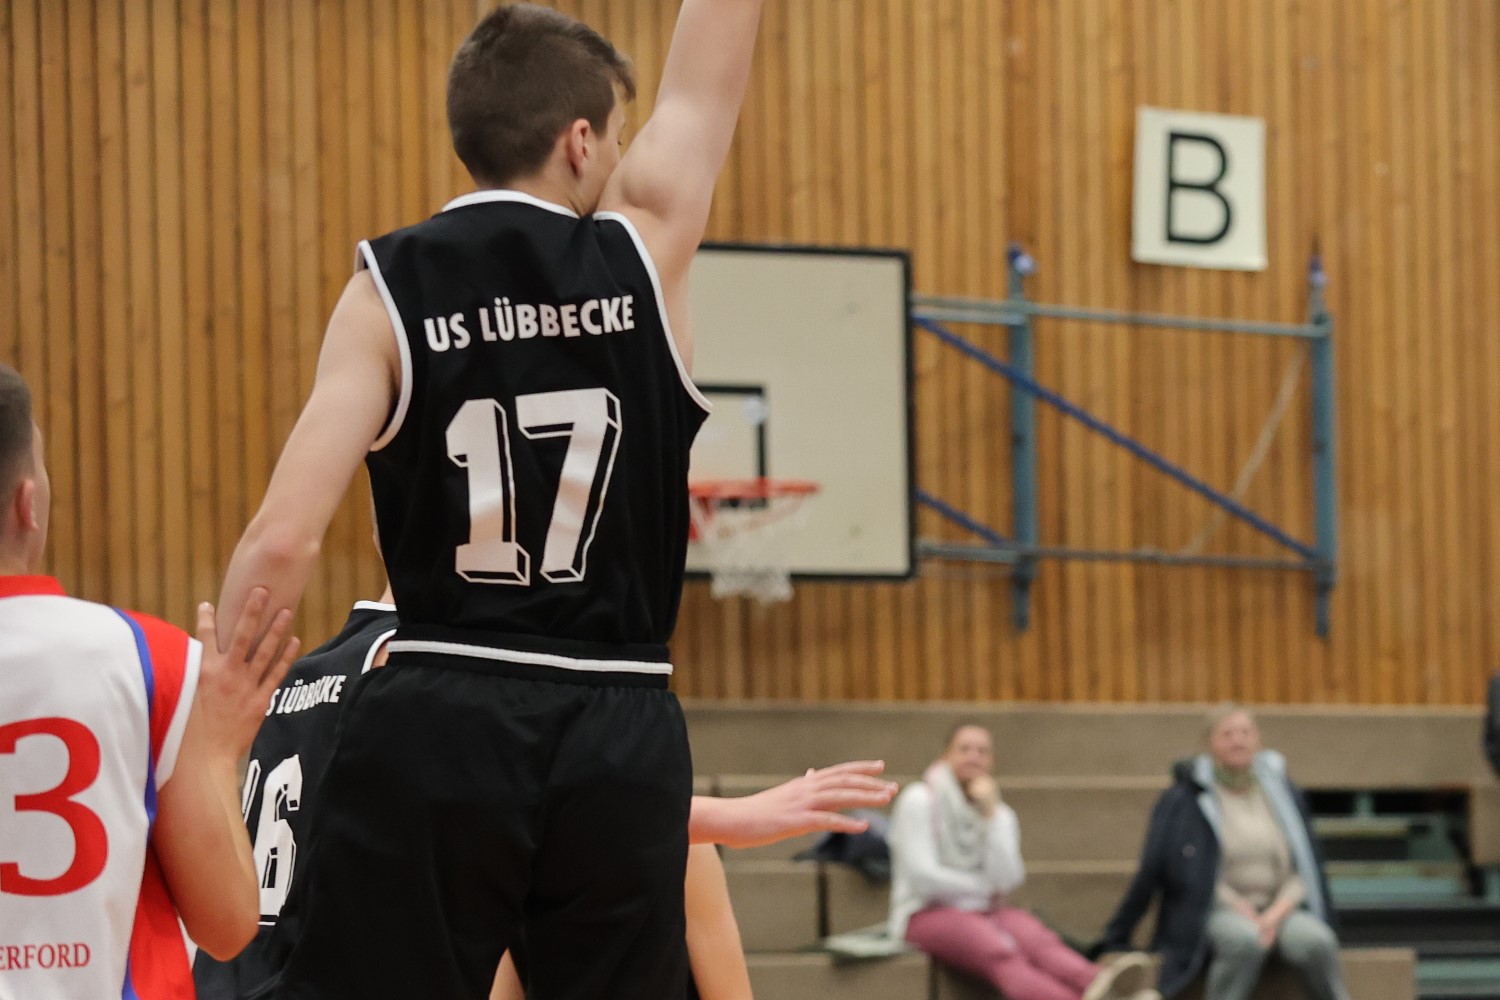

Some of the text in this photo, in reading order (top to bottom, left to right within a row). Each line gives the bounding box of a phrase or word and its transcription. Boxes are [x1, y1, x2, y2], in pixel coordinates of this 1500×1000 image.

[1166, 132, 1231, 245] B
[424, 295, 636, 352] US LÜBBECKE
[445, 387, 622, 587] 17
[275, 675, 347, 714] LÜBBKE
[0, 717, 109, 897] 3
[241, 754, 303, 926] 6
